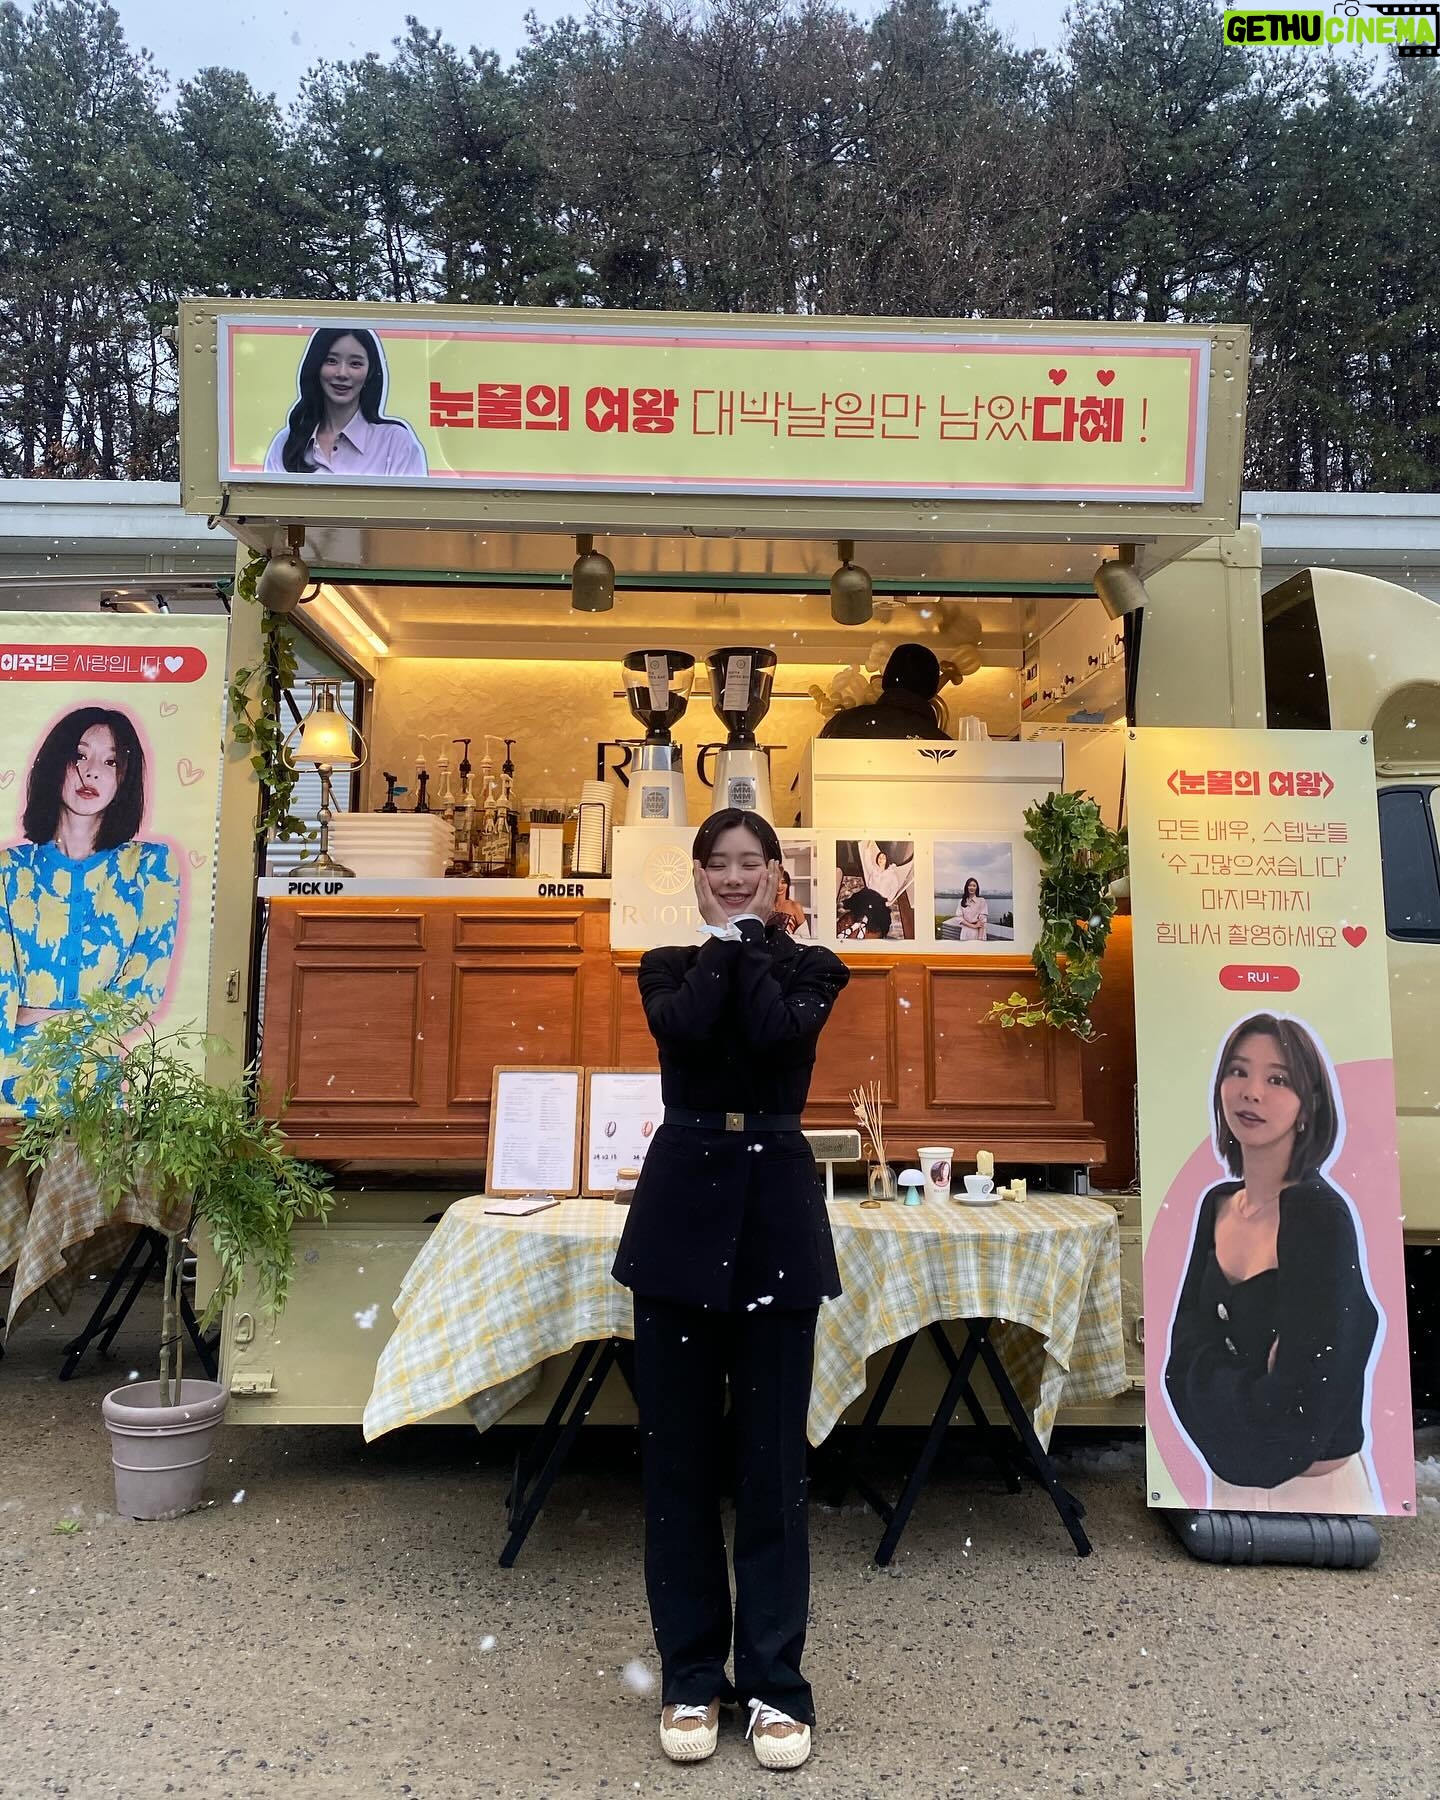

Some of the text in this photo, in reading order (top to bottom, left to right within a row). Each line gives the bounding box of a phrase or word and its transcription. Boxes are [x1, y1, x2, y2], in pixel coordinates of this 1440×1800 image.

[429, 381, 570, 432] 눈물의
[585, 385, 680, 434] 여왕
[693, 388, 927, 441] 대박날일만
[1, 653, 162, 674] 이주빈은 사랑입니다
[1157, 819, 1349, 844] 모든 배우, 스텝분들
[288, 882, 344, 895] PICK UP
[538, 884, 584, 897] ORDER
[1201, 888, 1311, 912] 마지막까지
[1156, 921, 1337, 948] 힘내서 촬영하세요
